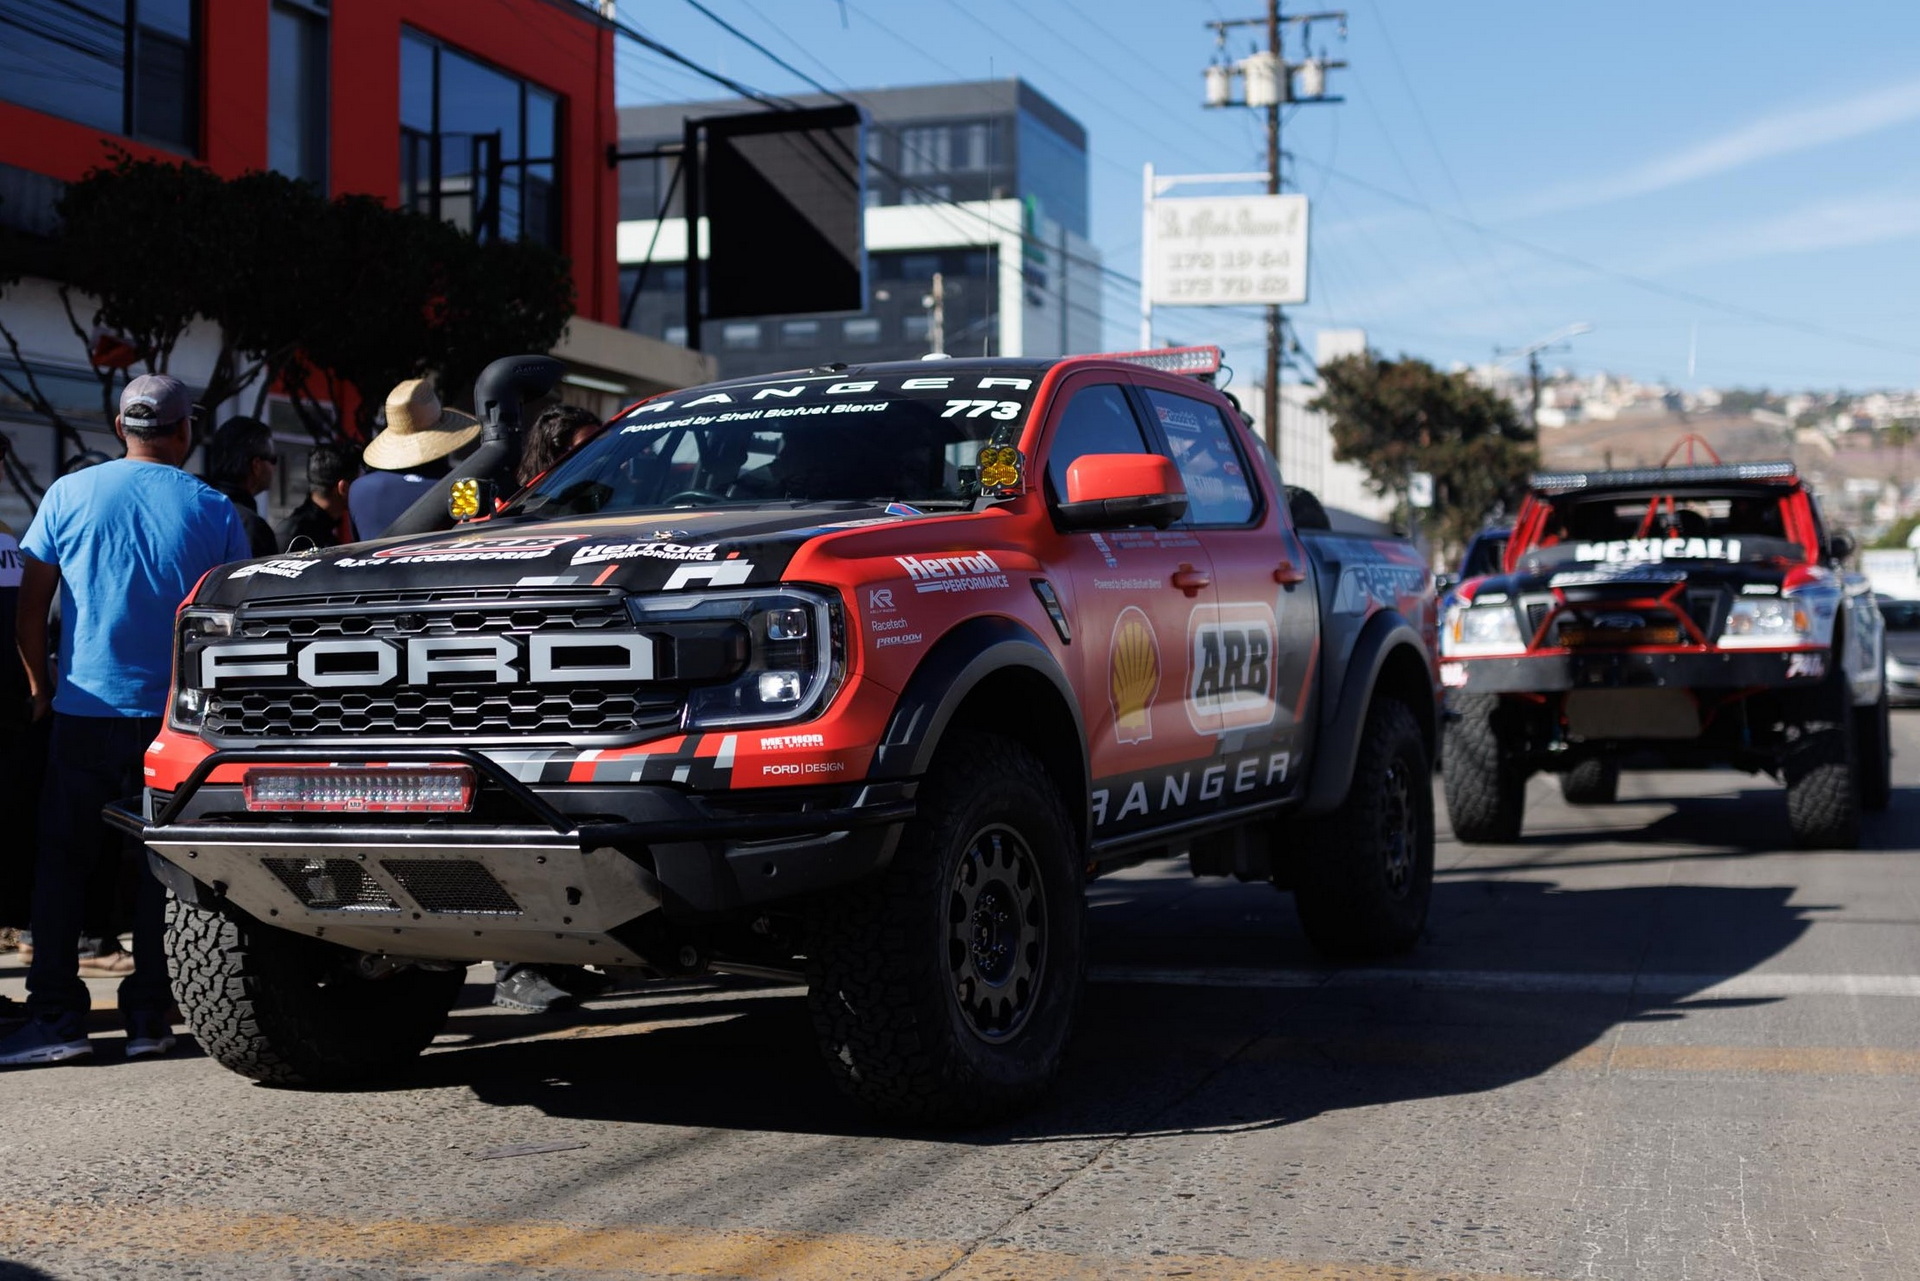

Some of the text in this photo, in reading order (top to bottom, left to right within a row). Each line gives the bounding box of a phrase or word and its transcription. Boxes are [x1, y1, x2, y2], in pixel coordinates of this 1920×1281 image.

[627, 377, 1033, 418] RANGER
[620, 402, 889, 434] Powered by Shell Biofuel Blend
[941, 400, 1022, 421] 773
[573, 543, 720, 559] Herrod
[605, 549, 716, 561] PERFORMANCE
[1575, 537, 1742, 564] MEXICALI
[894, 551, 1001, 580] Herrod
[942, 575, 1010, 593] PERFORMANCE
[870, 589, 895, 608] KR
[872, 617, 908, 631] Racetech
[201, 633, 654, 689] FORD
[1195, 628, 1268, 706] ARB
[760, 734, 824, 748] METHOD
[763, 763, 844, 775] FORD DESIGN
